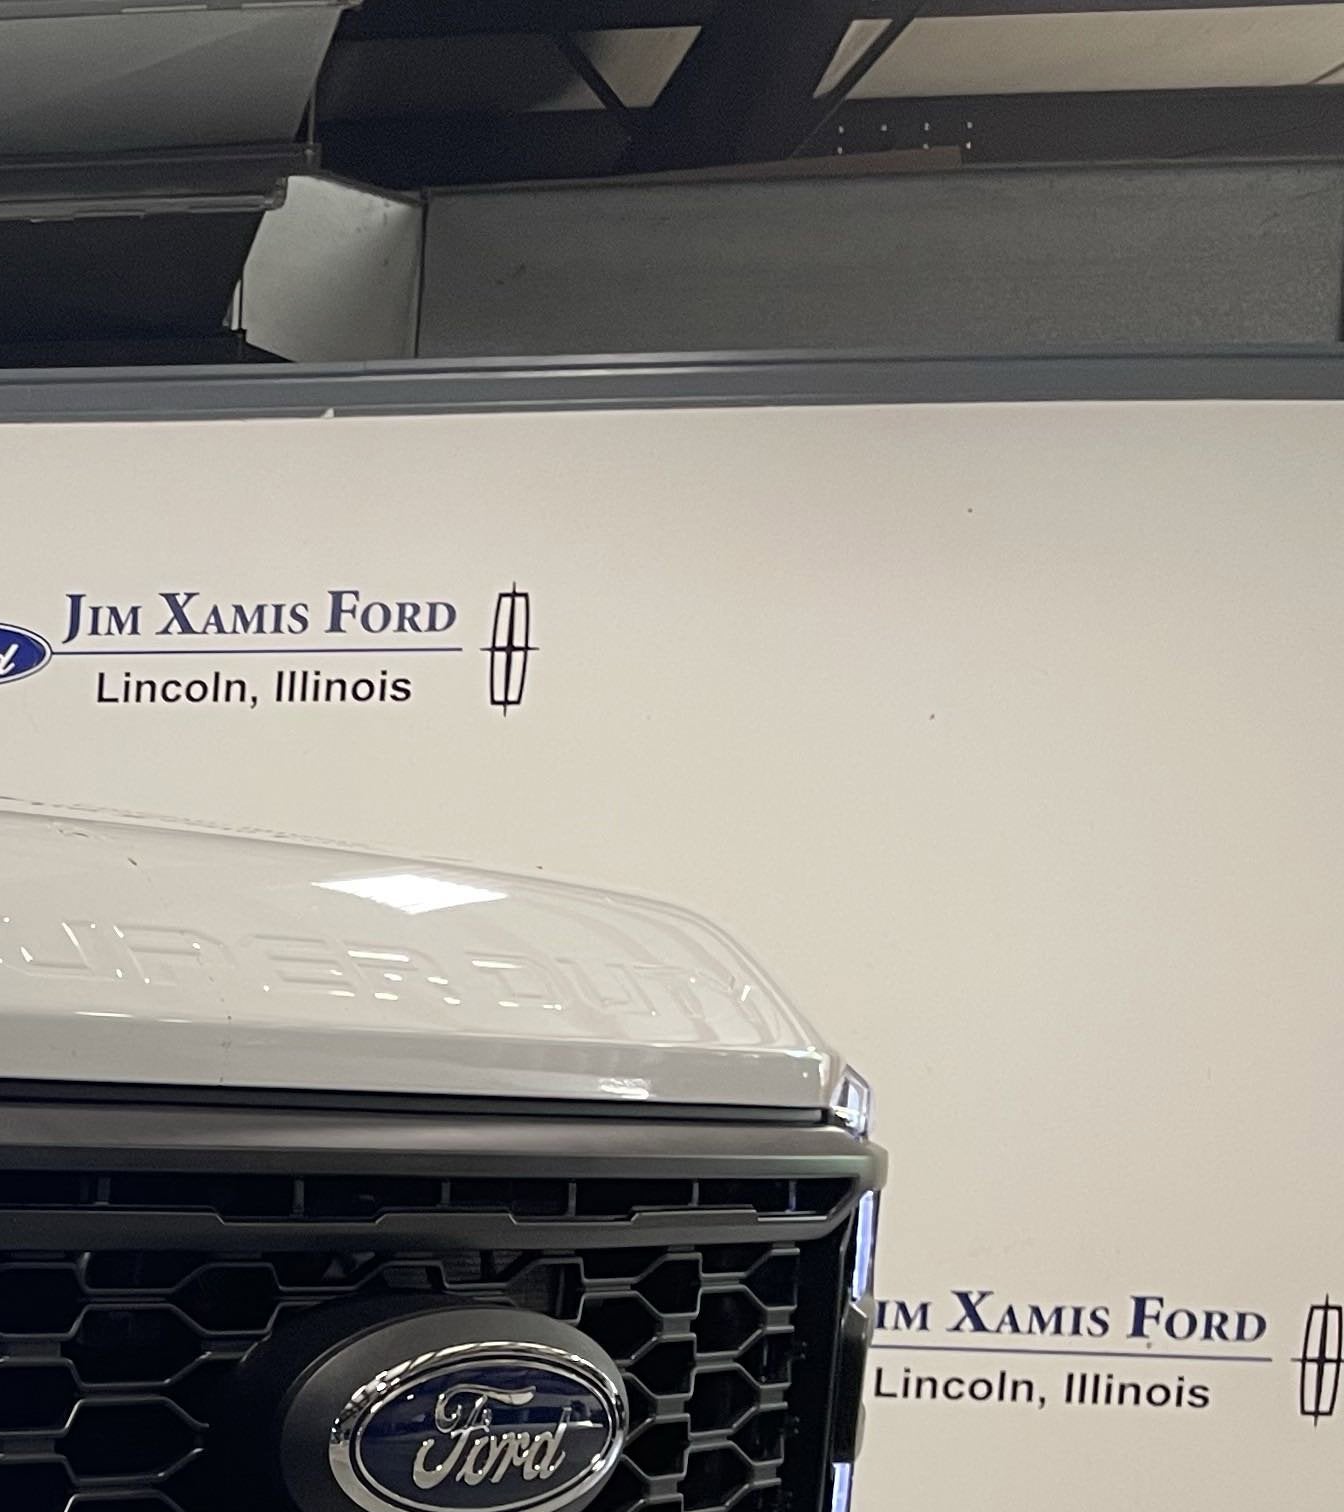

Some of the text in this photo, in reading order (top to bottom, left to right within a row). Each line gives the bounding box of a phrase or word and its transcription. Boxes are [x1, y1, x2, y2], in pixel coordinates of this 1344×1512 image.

[61, 590, 457, 645] JIM XAMIS FORD
[96, 670, 412, 709] Lincoln, Illinois
[875, 1290, 1268, 1342] IM XAMIS FORD
[873, 1367, 1211, 1410] Lincoln, Illinois
[413, 1382, 572, 1490] Ford
